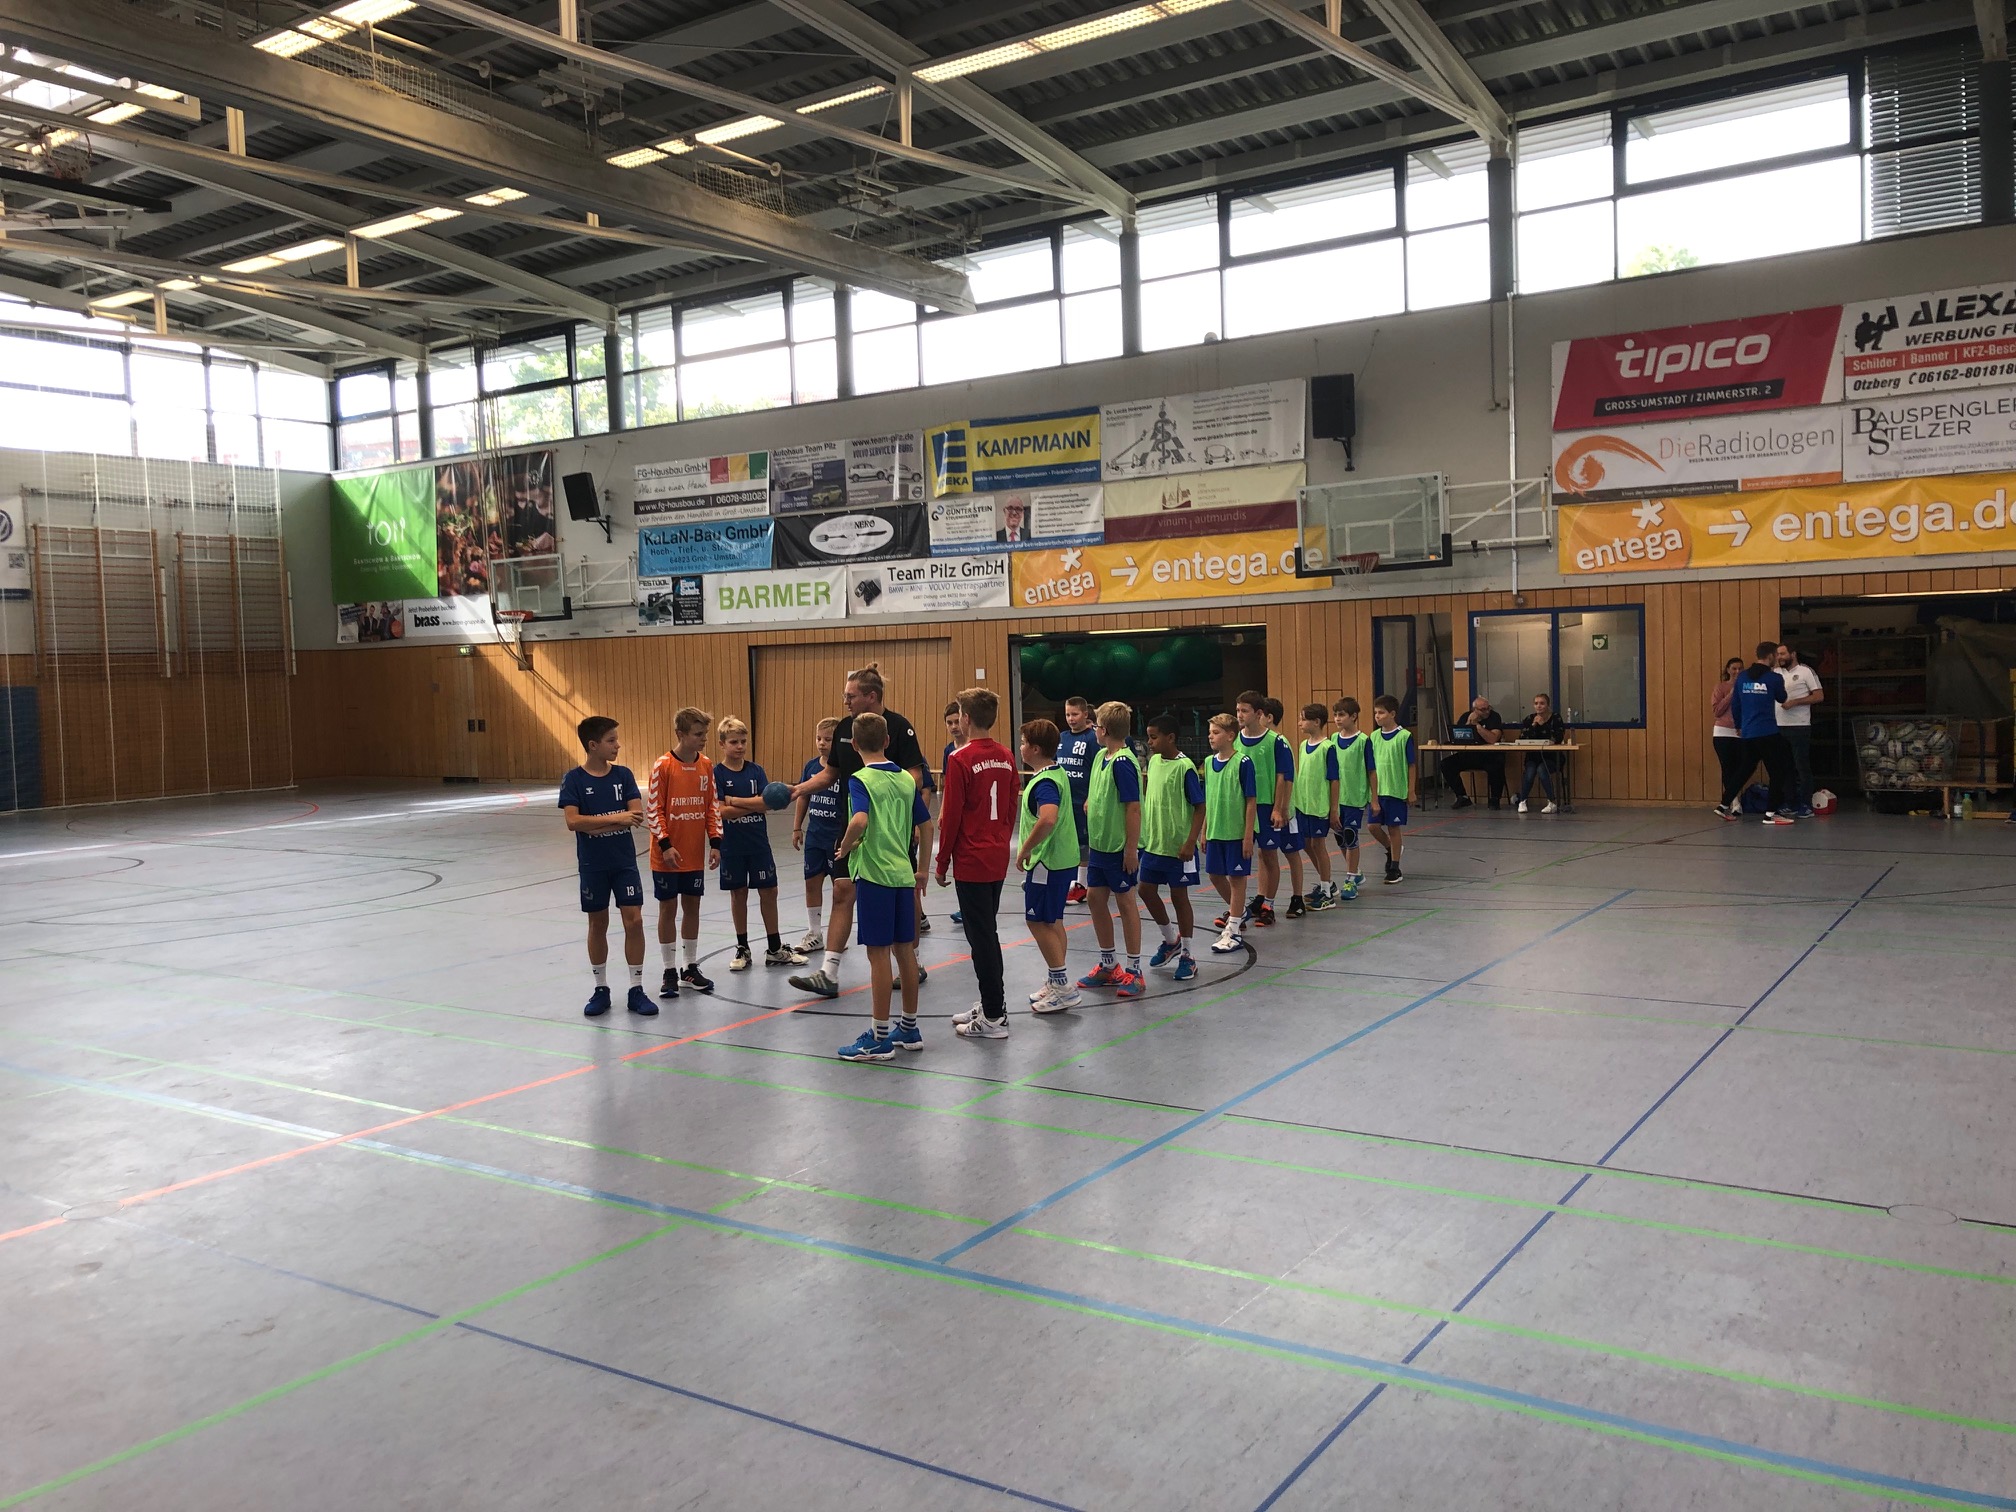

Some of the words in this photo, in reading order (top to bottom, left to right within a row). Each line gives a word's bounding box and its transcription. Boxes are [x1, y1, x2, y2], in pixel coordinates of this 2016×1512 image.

[1905, 325, 1997, 346] WERBUNG
[1615, 333, 1771, 383] tipico
[1853, 357, 1897, 372] Schilder
[1910, 351, 1950, 365] Banner
[1853, 377, 1901, 392] Otzberg
[1918, 363, 2016, 384] 06162-801818
[1605, 394, 1687, 412] GROSS-UMSTADT
[1697, 386, 1762, 402] ZIMMERSTR.
[1765, 385, 1772, 395] 2
[976, 429, 1091, 458] KAMPMANN
[1868, 420, 1971, 456] STELZER
[805, 444, 823, 453] Team
[824, 442, 837, 451] Pilz
[637, 465, 684, 479] FG-Hausbau
[684, 462, 709, 474] GmbH
[638, 498, 706, 512] www.fg-hausbau.de
[973, 504, 993, 514] STEIN
[1157, 516, 1188, 528] vinum
[1194, 510, 1247, 525] autmundis
[725, 522, 770, 540] GmbH
[1576, 527, 1683, 571] entega
[887, 567, 926, 582] Team
[930, 563, 957, 579] Pilz
[961, 559, 1005, 577] GmbH
[718, 581, 832, 611] BARMER
[888, 585, 904, 594] BMW
[928, 582, 951, 592] VOLVO
[952, 580, 1006, 592] Vertragspartner
[1024, 570, 1096, 605] entega
[413, 614, 440, 628] brass
[1071, 740, 1088, 757] 28
[1259, 745, 1265, 755] 5
[699, 775, 709, 792] 12
[989, 780, 999, 821] 1
[693, 878, 703, 888] 27
[758, 870, 767, 880] 10
[626, 885, 635, 897] 13
